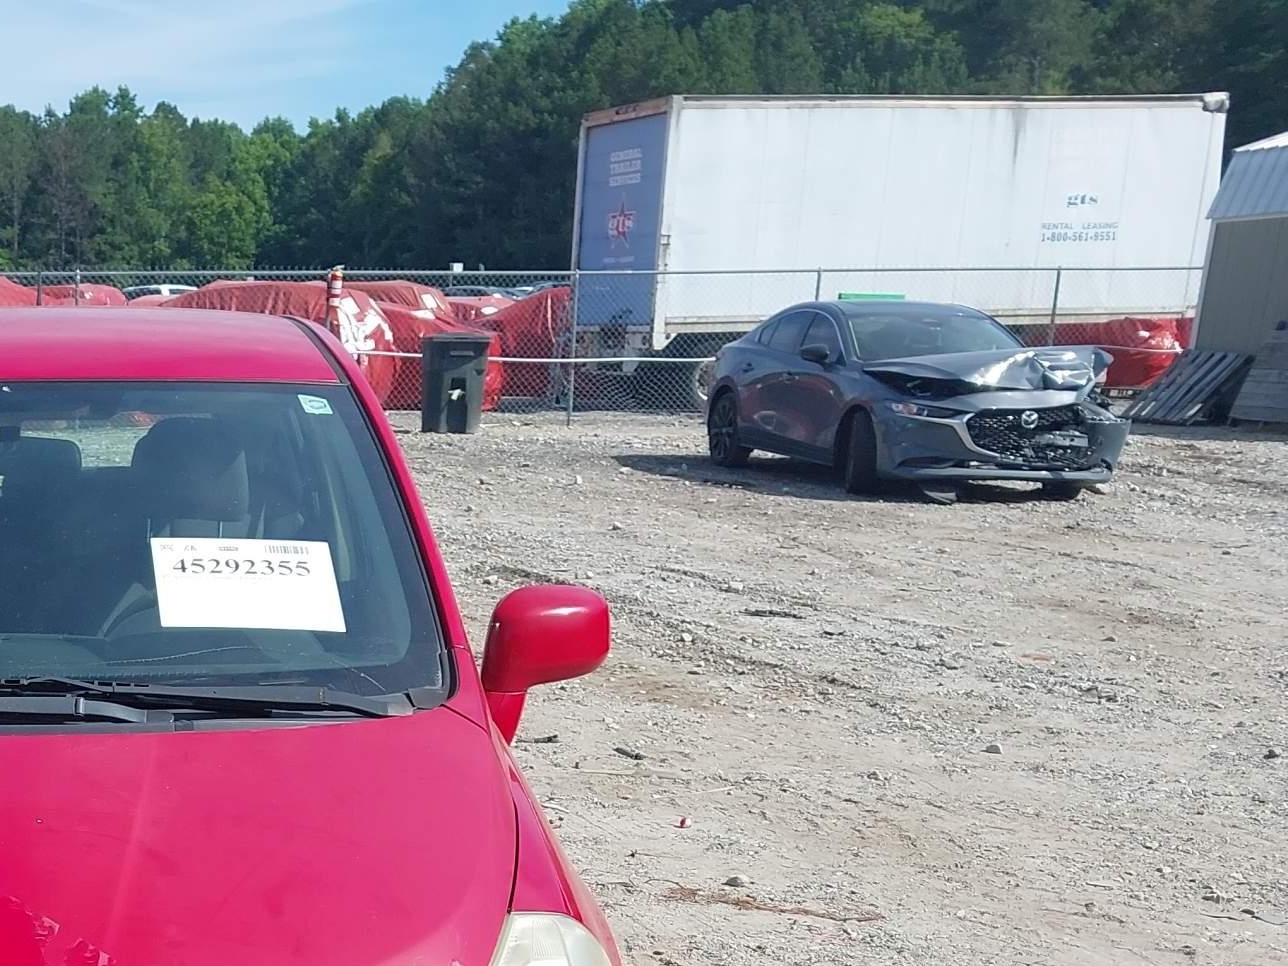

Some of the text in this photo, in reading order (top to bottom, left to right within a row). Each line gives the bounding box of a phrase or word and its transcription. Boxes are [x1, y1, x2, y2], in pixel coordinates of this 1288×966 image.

[1041, 222, 1119, 230] RENTAL LEASING
[172, 558, 310, 577] 45292355
